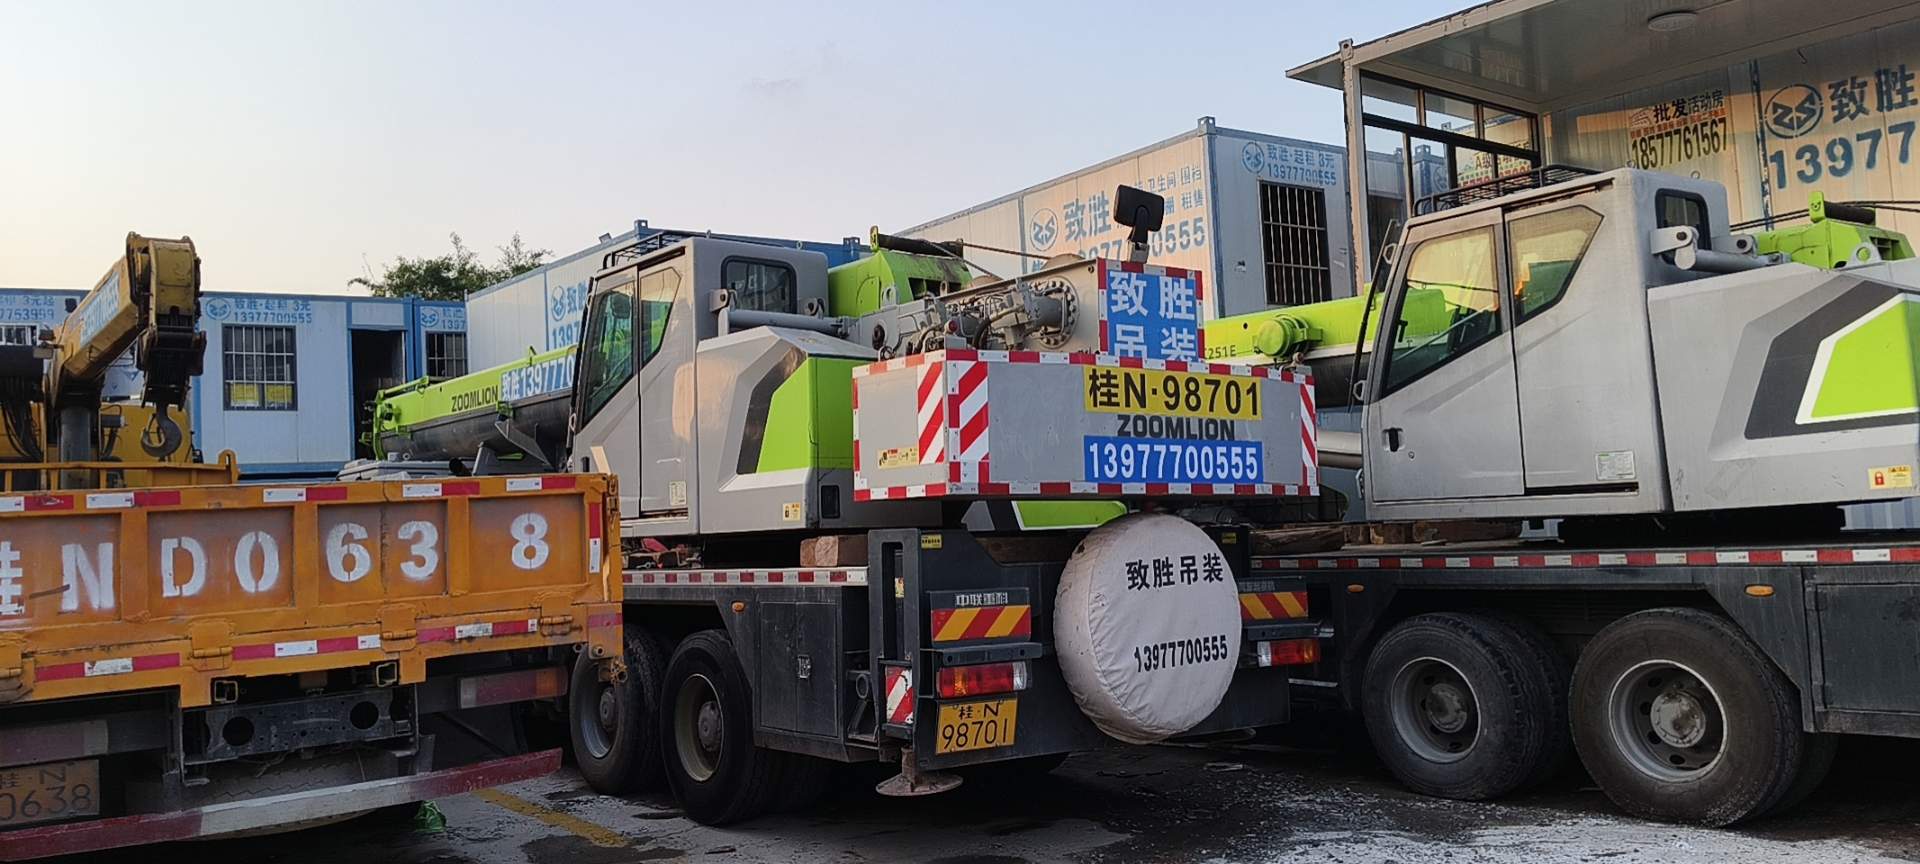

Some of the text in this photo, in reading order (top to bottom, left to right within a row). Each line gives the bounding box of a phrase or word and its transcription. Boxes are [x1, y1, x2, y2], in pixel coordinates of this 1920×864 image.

[1653, 89, 1724, 123] 批发活动房
[1828, 64, 1918, 123] 致胜
[1631, 116, 1727, 170] 18577761567
[1769, 120, 1915, 190] 13977
[1267, 163, 1336, 185] 13977700555
[1064, 191, 1112, 241] 致胜
[1109, 271, 1195, 321] 致胜
[234, 312, 312, 323] 13977700555
[1113, 323, 1197, 362] 吊装
[1205, 344, 1236, 360] 251E
[451, 385, 498, 412] ZOOMLION
[1089, 368, 1259, 416] 桂N·98701
[1117, 414, 1236, 440] ZOOMLION
[1089, 442, 1259, 480] 13977700555
[1125, 553, 1223, 591] 致胜吊装
[1134, 634, 1228, 673] 13977700555
[942, 718, 1008, 750] 98701
